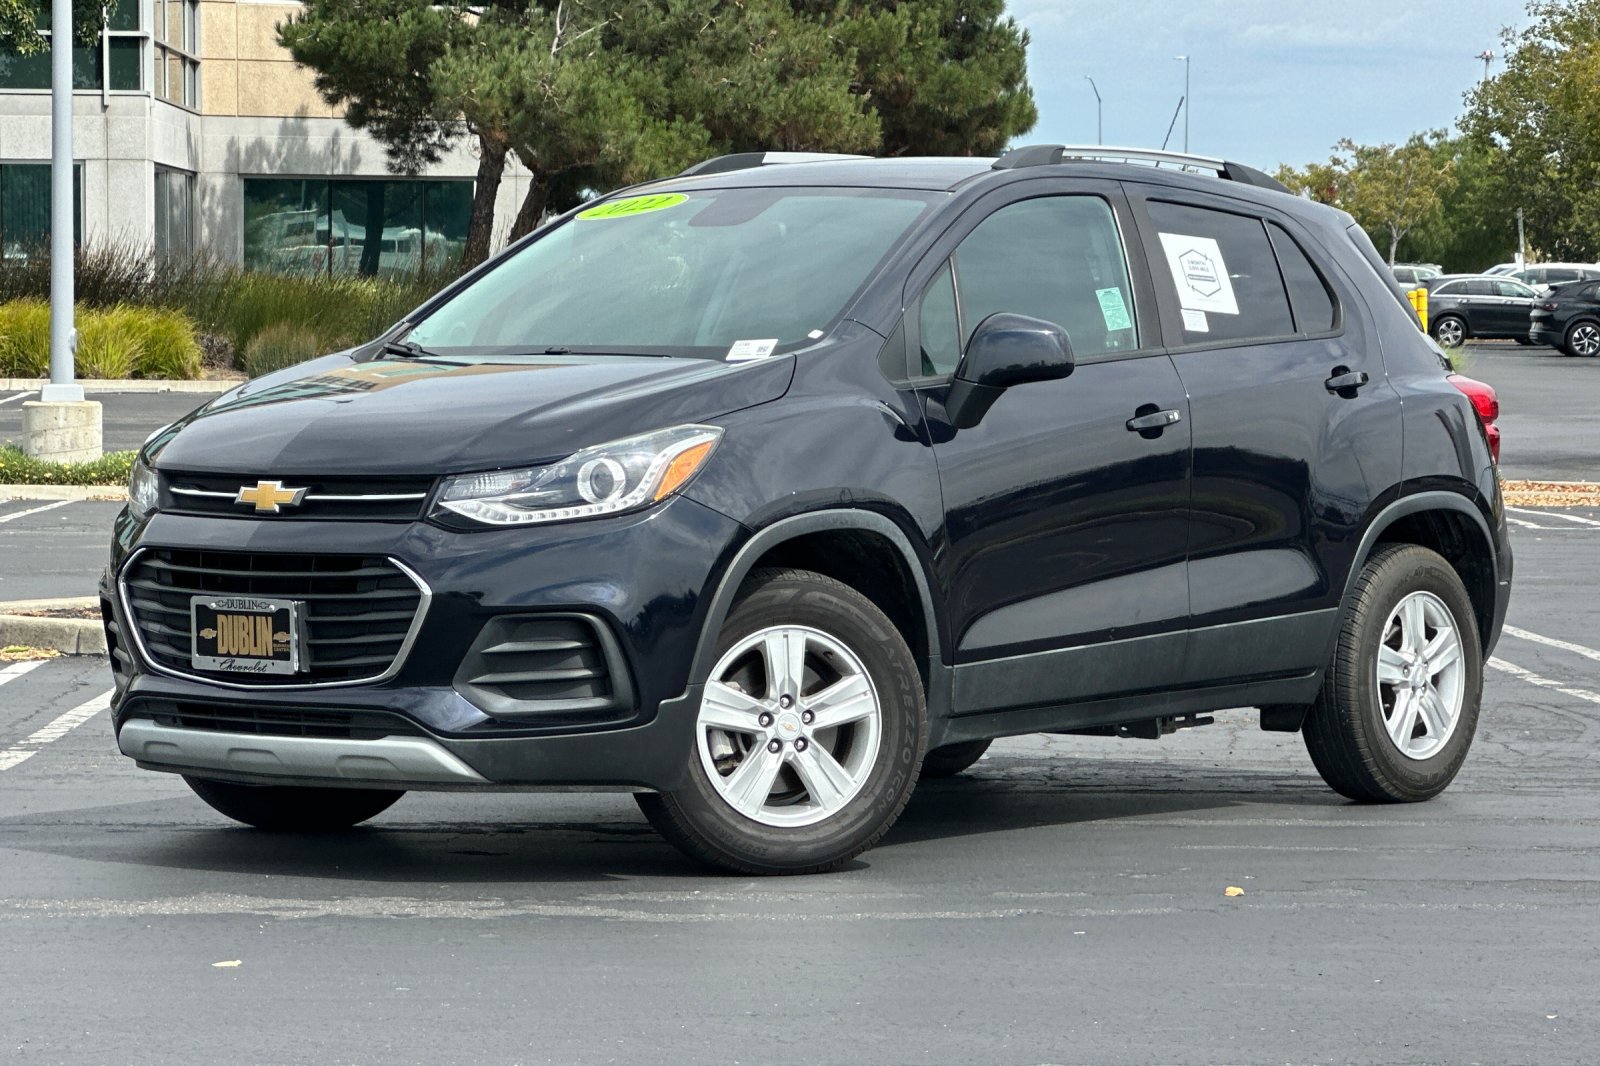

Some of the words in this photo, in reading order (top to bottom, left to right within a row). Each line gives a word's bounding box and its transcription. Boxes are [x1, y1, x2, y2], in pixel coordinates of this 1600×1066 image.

[226, 599, 259, 610] DUBLIN
[216, 614, 274, 657] DUBLIN
[219, 658, 268, 673] Chevrolet
[879, 644, 915, 765] ATREZZO
